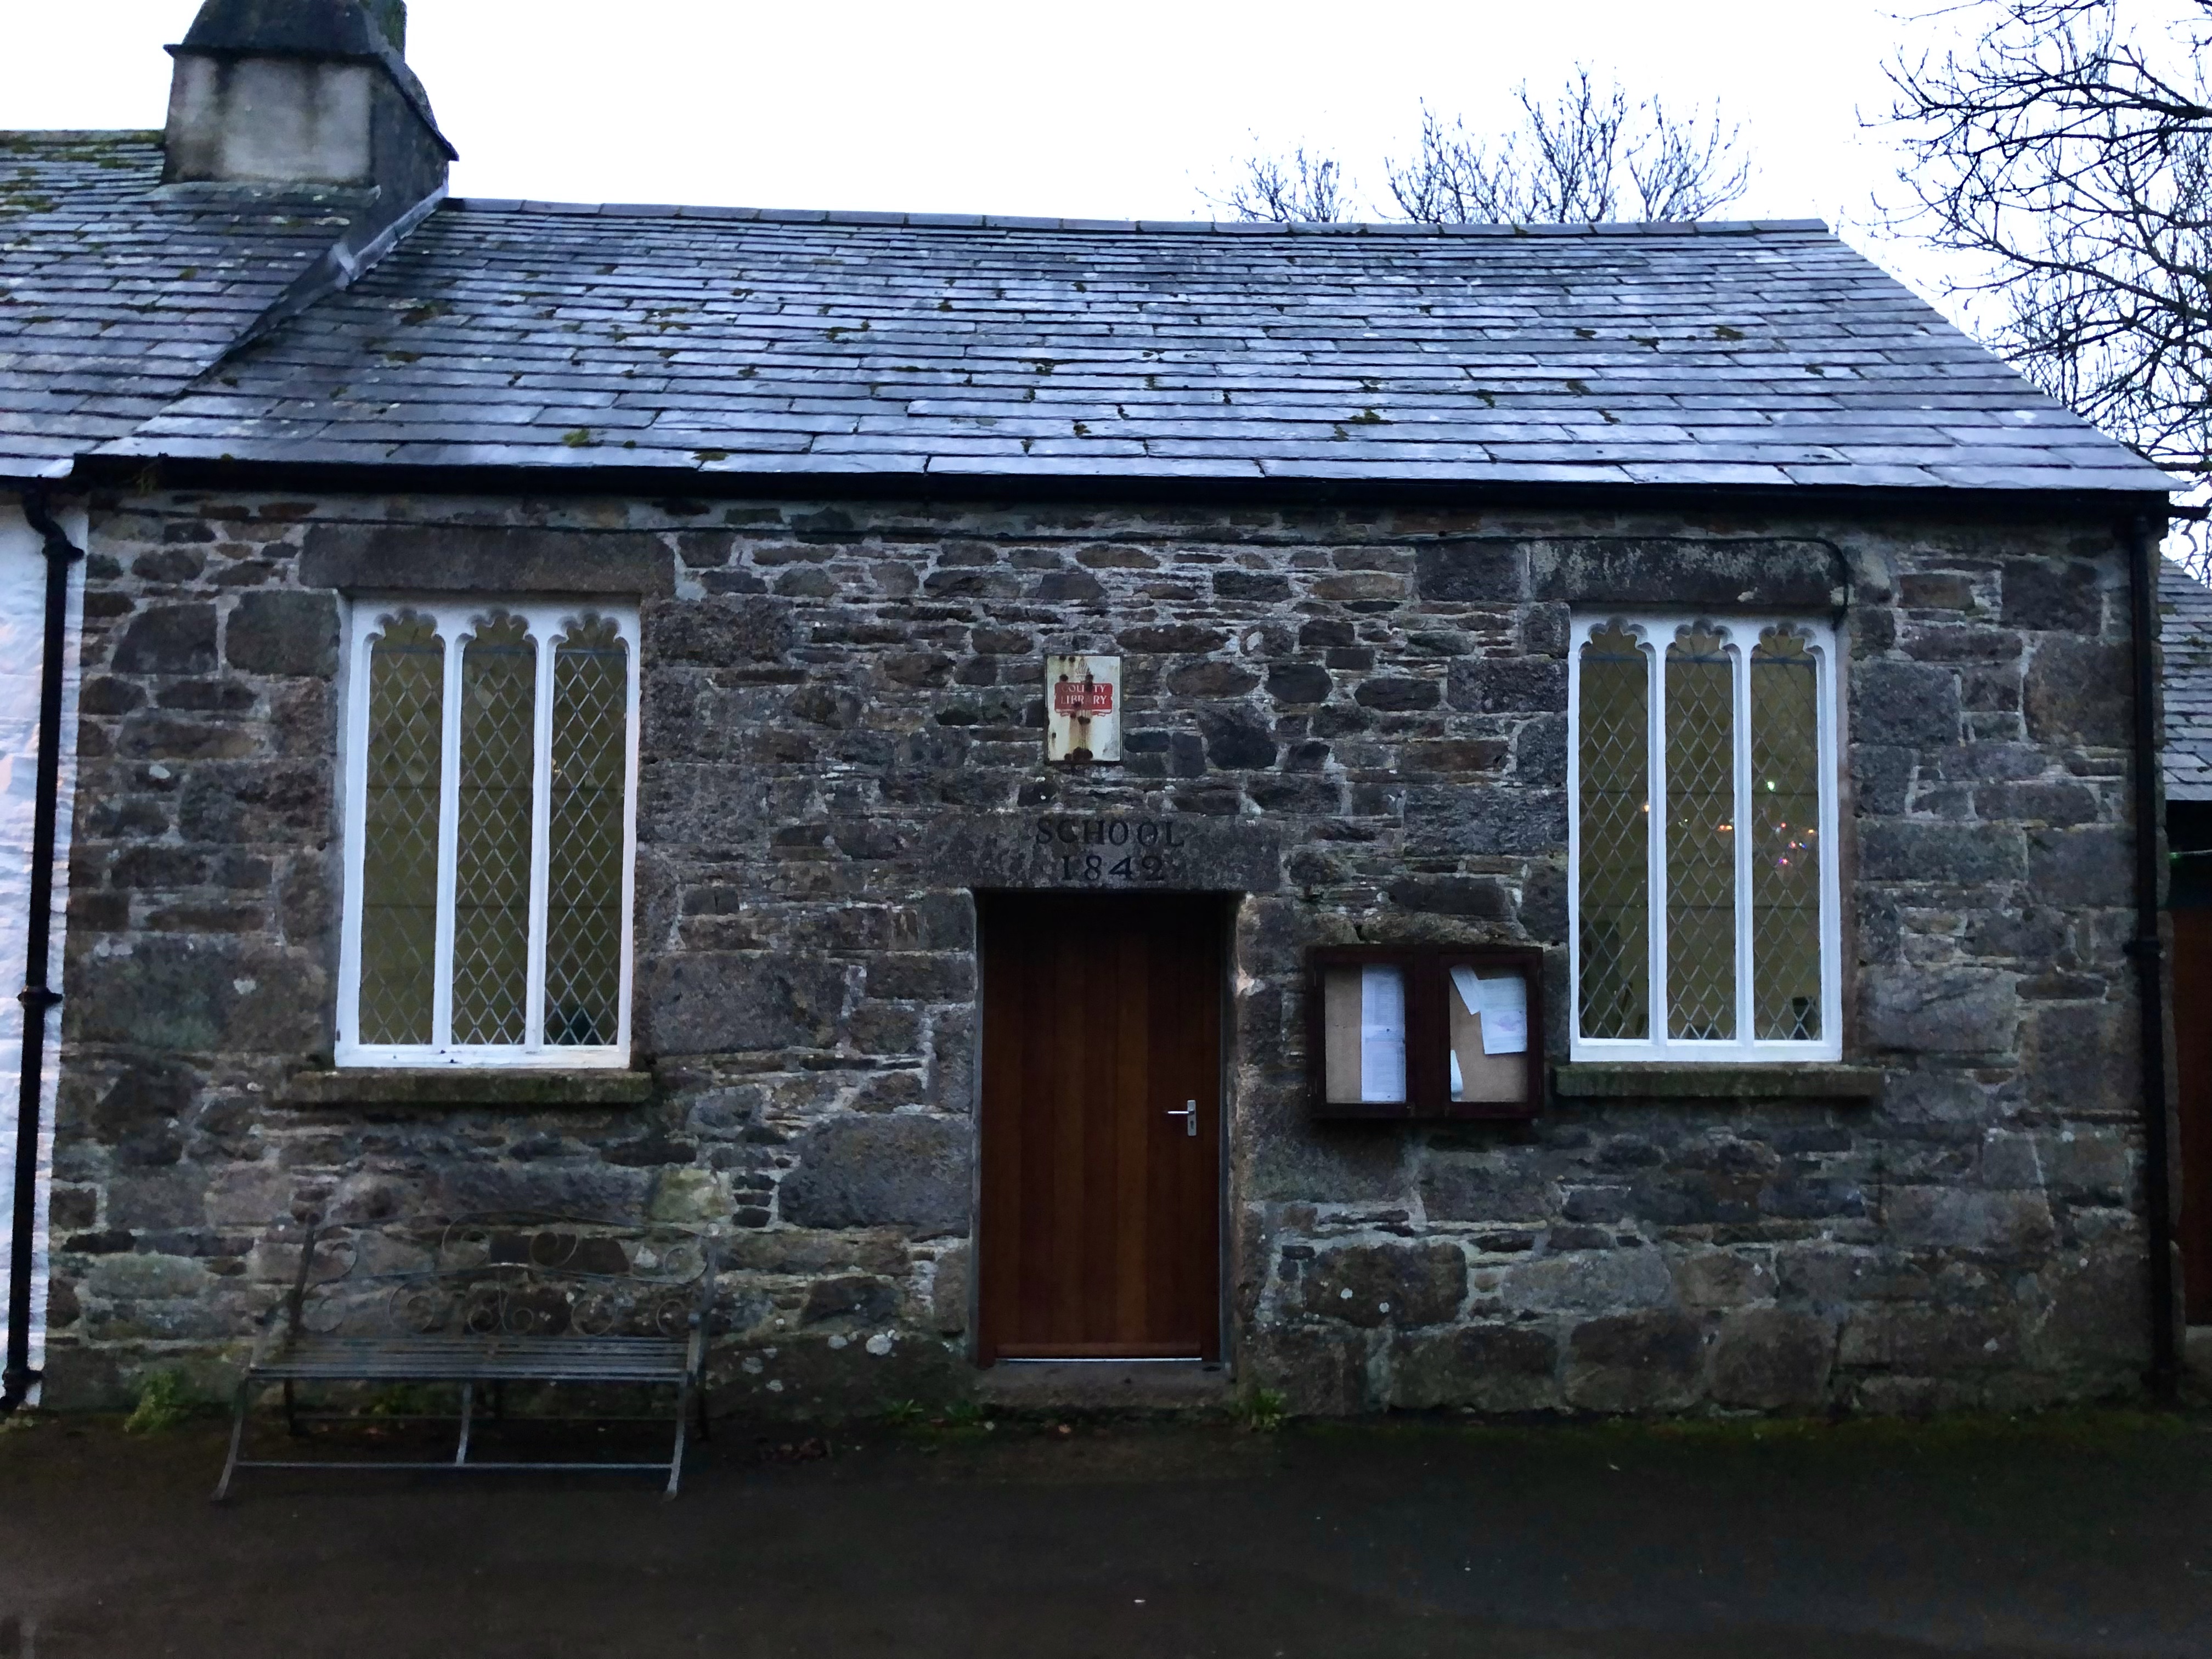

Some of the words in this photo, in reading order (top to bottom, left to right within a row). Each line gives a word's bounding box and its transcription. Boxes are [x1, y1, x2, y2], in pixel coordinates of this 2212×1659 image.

[1061, 684, 1106, 693] COUTY
[1060, 695, 1107, 704] LIBRRY
[1036, 817, 1184, 847] SCHOOL
